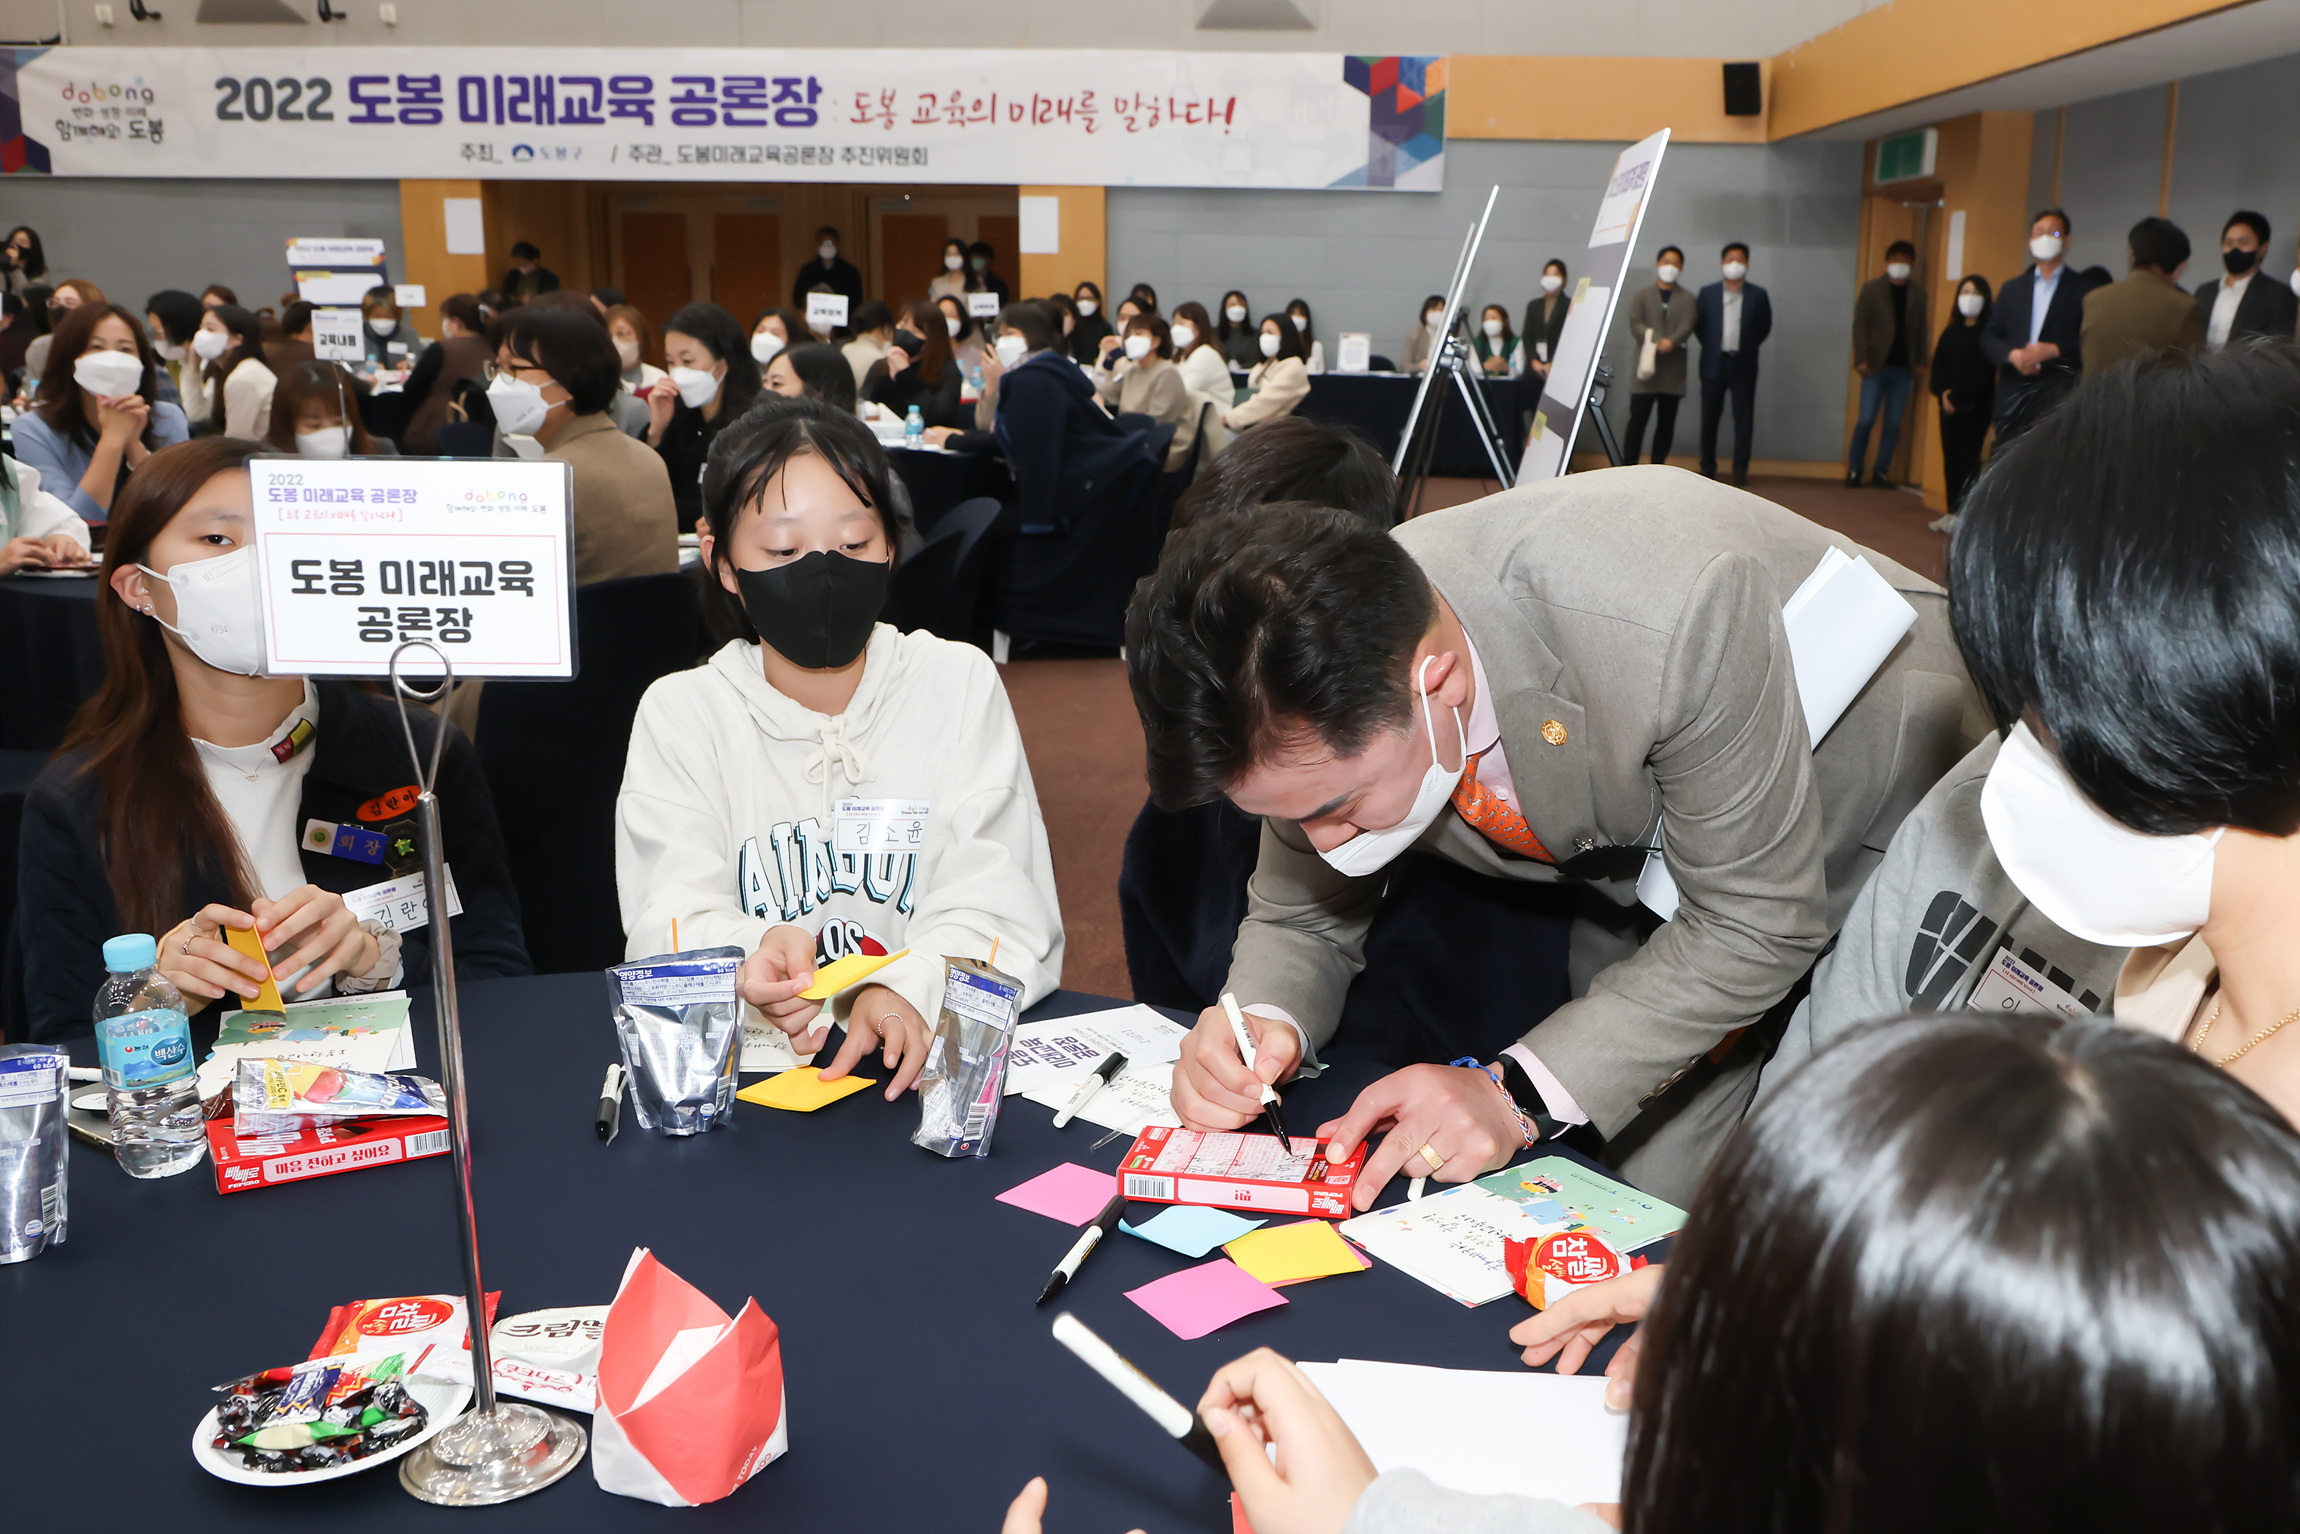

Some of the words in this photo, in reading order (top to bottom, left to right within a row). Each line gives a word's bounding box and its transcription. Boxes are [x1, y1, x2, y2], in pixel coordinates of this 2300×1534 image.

[62, 80, 155, 105] dobong
[216, 78, 335, 121] 2022
[348, 75, 443, 125] 도봉
[459, 75, 655, 126] 미래교육
[669, 76, 823, 126] 공론장
[849, 88, 898, 126] 도봉
[910, 89, 997, 126] 교육의
[1008, 90, 1102, 134] 미래를
[1114, 95, 1237, 133] 말하다!
[128, 117, 164, 144] 도봉
[677, 144, 835, 166] 도봉미래교육공론장
[841, 145, 929, 167] 추진위원회
[268, 474, 304, 486] 2022
[268, 488, 298, 503] 도봉
[303, 488, 365, 503] 미래교육
[370, 488, 418, 504] 공론장
[465, 489, 528, 504] dobong
[291, 559, 366, 596] 도봉
[379, 560, 535, 597] 미래교육
[357, 606, 473, 643] 공론장
[856, 821, 923, 845] 김소윤
[338, 834, 382, 856] 회장
[619, 969, 653, 981] 영양정보
[950, 967, 971, 983] 영양정보
[154, 1043, 186, 1060] 백산수
[1019, 1037, 1078, 1069] 미래교육
[1051, 1036, 1101, 1060] 공론장
[275, 1161, 303, 1175] 마음
[306, 1153, 347, 1170] 전하고
[350, 1144, 391, 1162] 싶어요
[224, 1165, 260, 1182] 빼빼로
[227, 1180, 260, 1190] PEPERO
[1312, 1196, 1345, 1215] 빼빼로
[1313, 1190, 1343, 1198] PEPERO
[737, 1445, 758, 1480] TODAY
